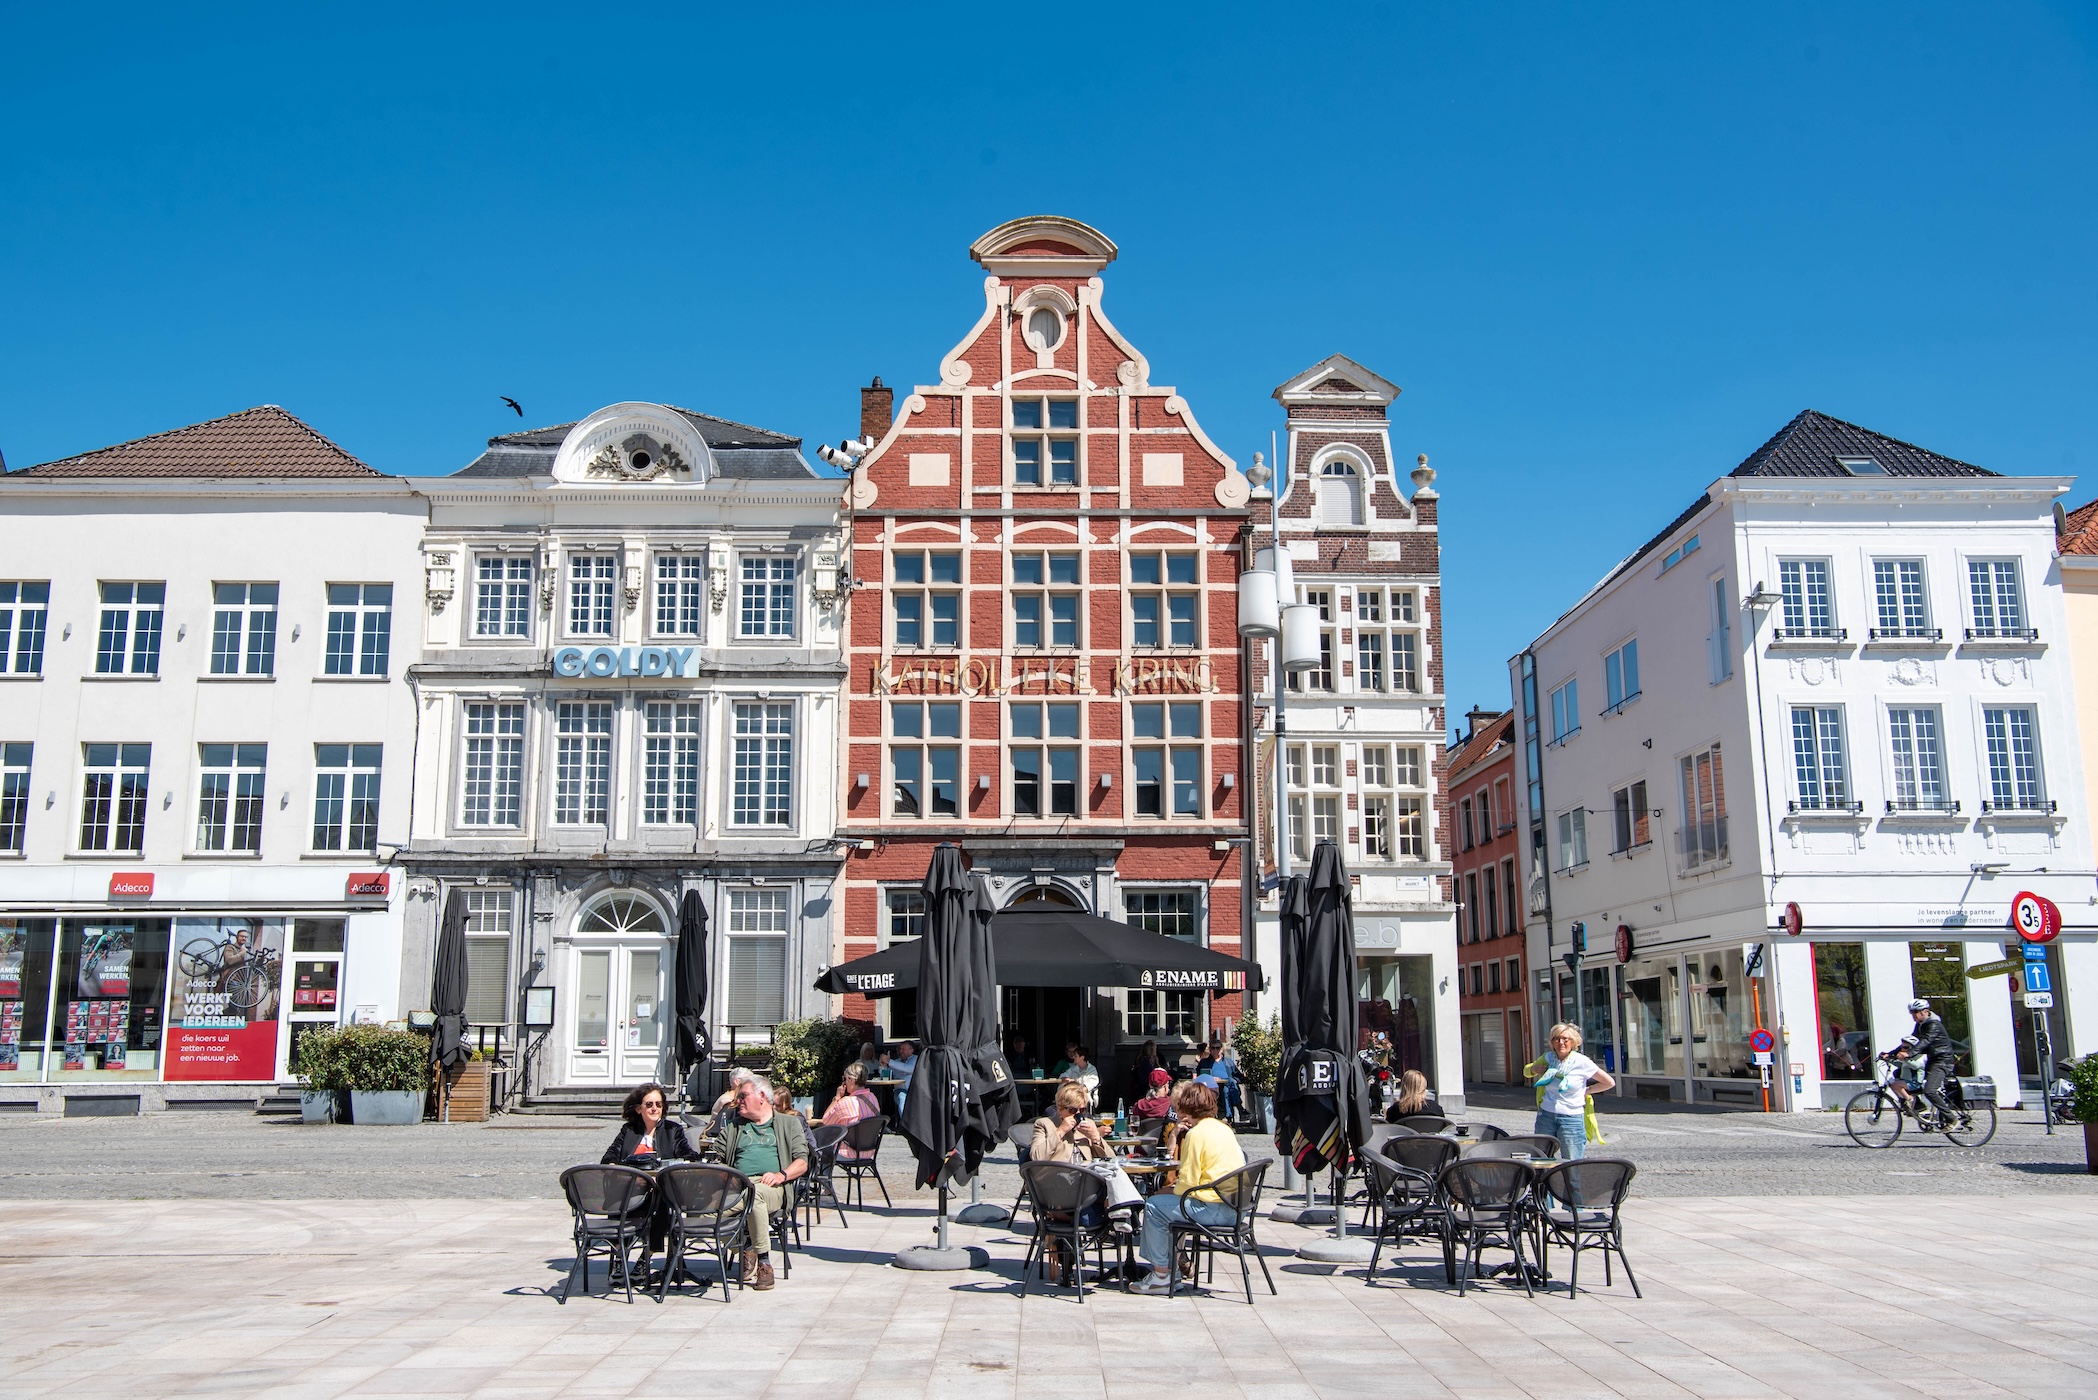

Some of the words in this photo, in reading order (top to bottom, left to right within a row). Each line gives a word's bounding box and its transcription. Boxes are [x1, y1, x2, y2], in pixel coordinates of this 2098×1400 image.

[555, 647, 695, 677] GOLDY
[1114, 658, 1219, 693] KRING
[114, 883, 149, 893] Adecco
[350, 883, 386, 893] Adecco
[1978, 960, 2018, 972] LIEDTSPARK
[99, 972, 130, 980] WERKEN.
[858, 973, 895, 990] L'ETAGE
[1155, 970, 1218, 983] ENAME
[186, 979, 217, 988] Adecco
[184, 993, 233, 1004] WERKT
[184, 1004, 224, 1015] VOOR
[182, 1016, 246, 1027] IEDEREEN
[181, 1034, 194, 1042] die
[195, 1034, 217, 1042] koers
[218, 1034, 230, 1042] wil
[180, 1044, 205, 1052] zetten
[196, 1053, 225, 1062] nieuwe
[225, 1053, 241, 1063] job.
